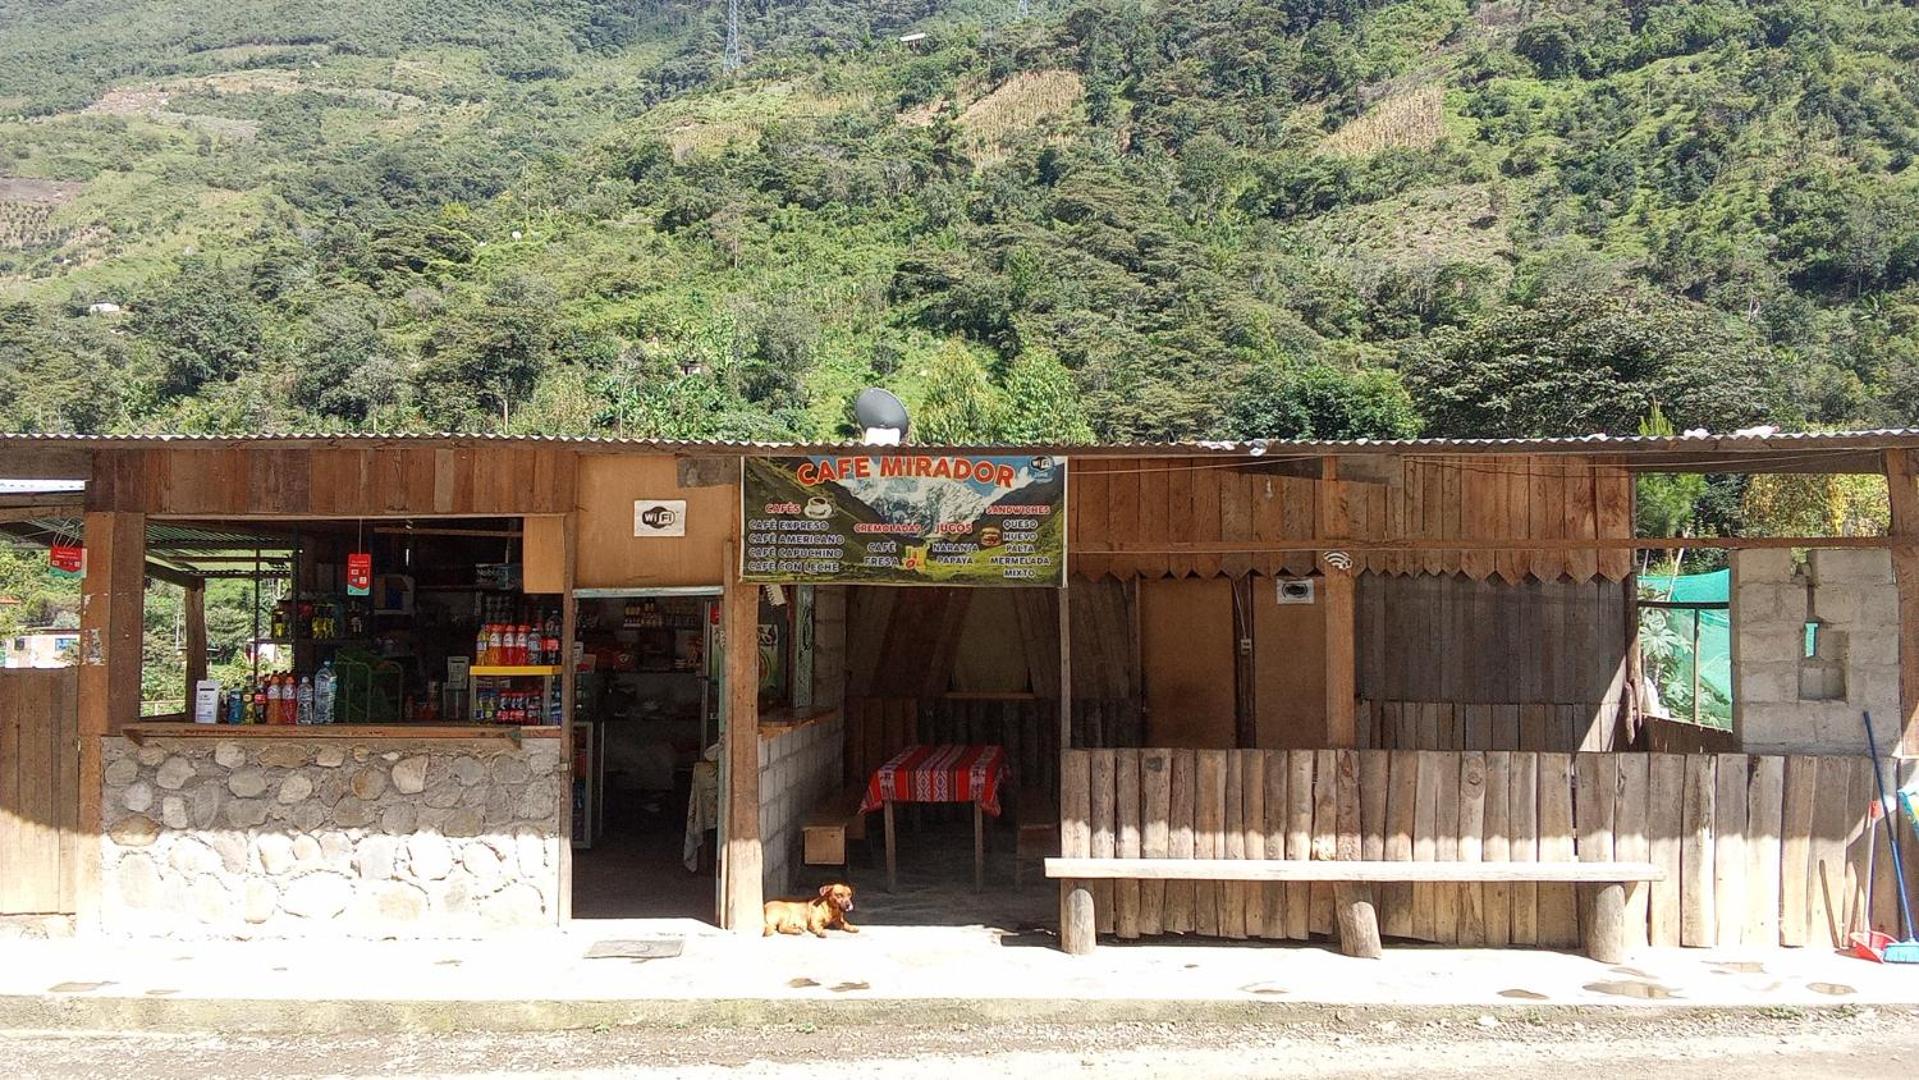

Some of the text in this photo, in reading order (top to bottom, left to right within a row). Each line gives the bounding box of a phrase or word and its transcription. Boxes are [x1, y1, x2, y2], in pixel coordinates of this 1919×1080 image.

[796, 456, 1016, 489] CAFE MIRADOR
[765, 502, 801, 514] CAFÉS
[986, 505, 1051, 514] SANDWICHES
[748, 519, 829, 531] CAFÉ EXPRESO
[854, 523, 921, 534] CREMOLADAS
[935, 523, 973, 534] JUGOS
[1003, 519, 1038, 530] QUESO
[748, 533, 845, 545] CAFÉ AMERICANO
[1003, 532, 1038, 542] HUEVO
[866, 541, 897, 552] CAFÉ
[932, 543, 979, 552] NARANJA
[1005, 544, 1036, 553] PALTA
[748, 546, 844, 559] CAFÉ CAPUCHINO
[864, 557, 900, 566] FRESA
[936, 556, 975, 565] PAPAYA
[989, 557, 1051, 566] MERMELADA
[778, 562, 802, 572] CON
[804, 562, 840, 572] LECHE
[1003, 568, 1036, 577] MIXTO
